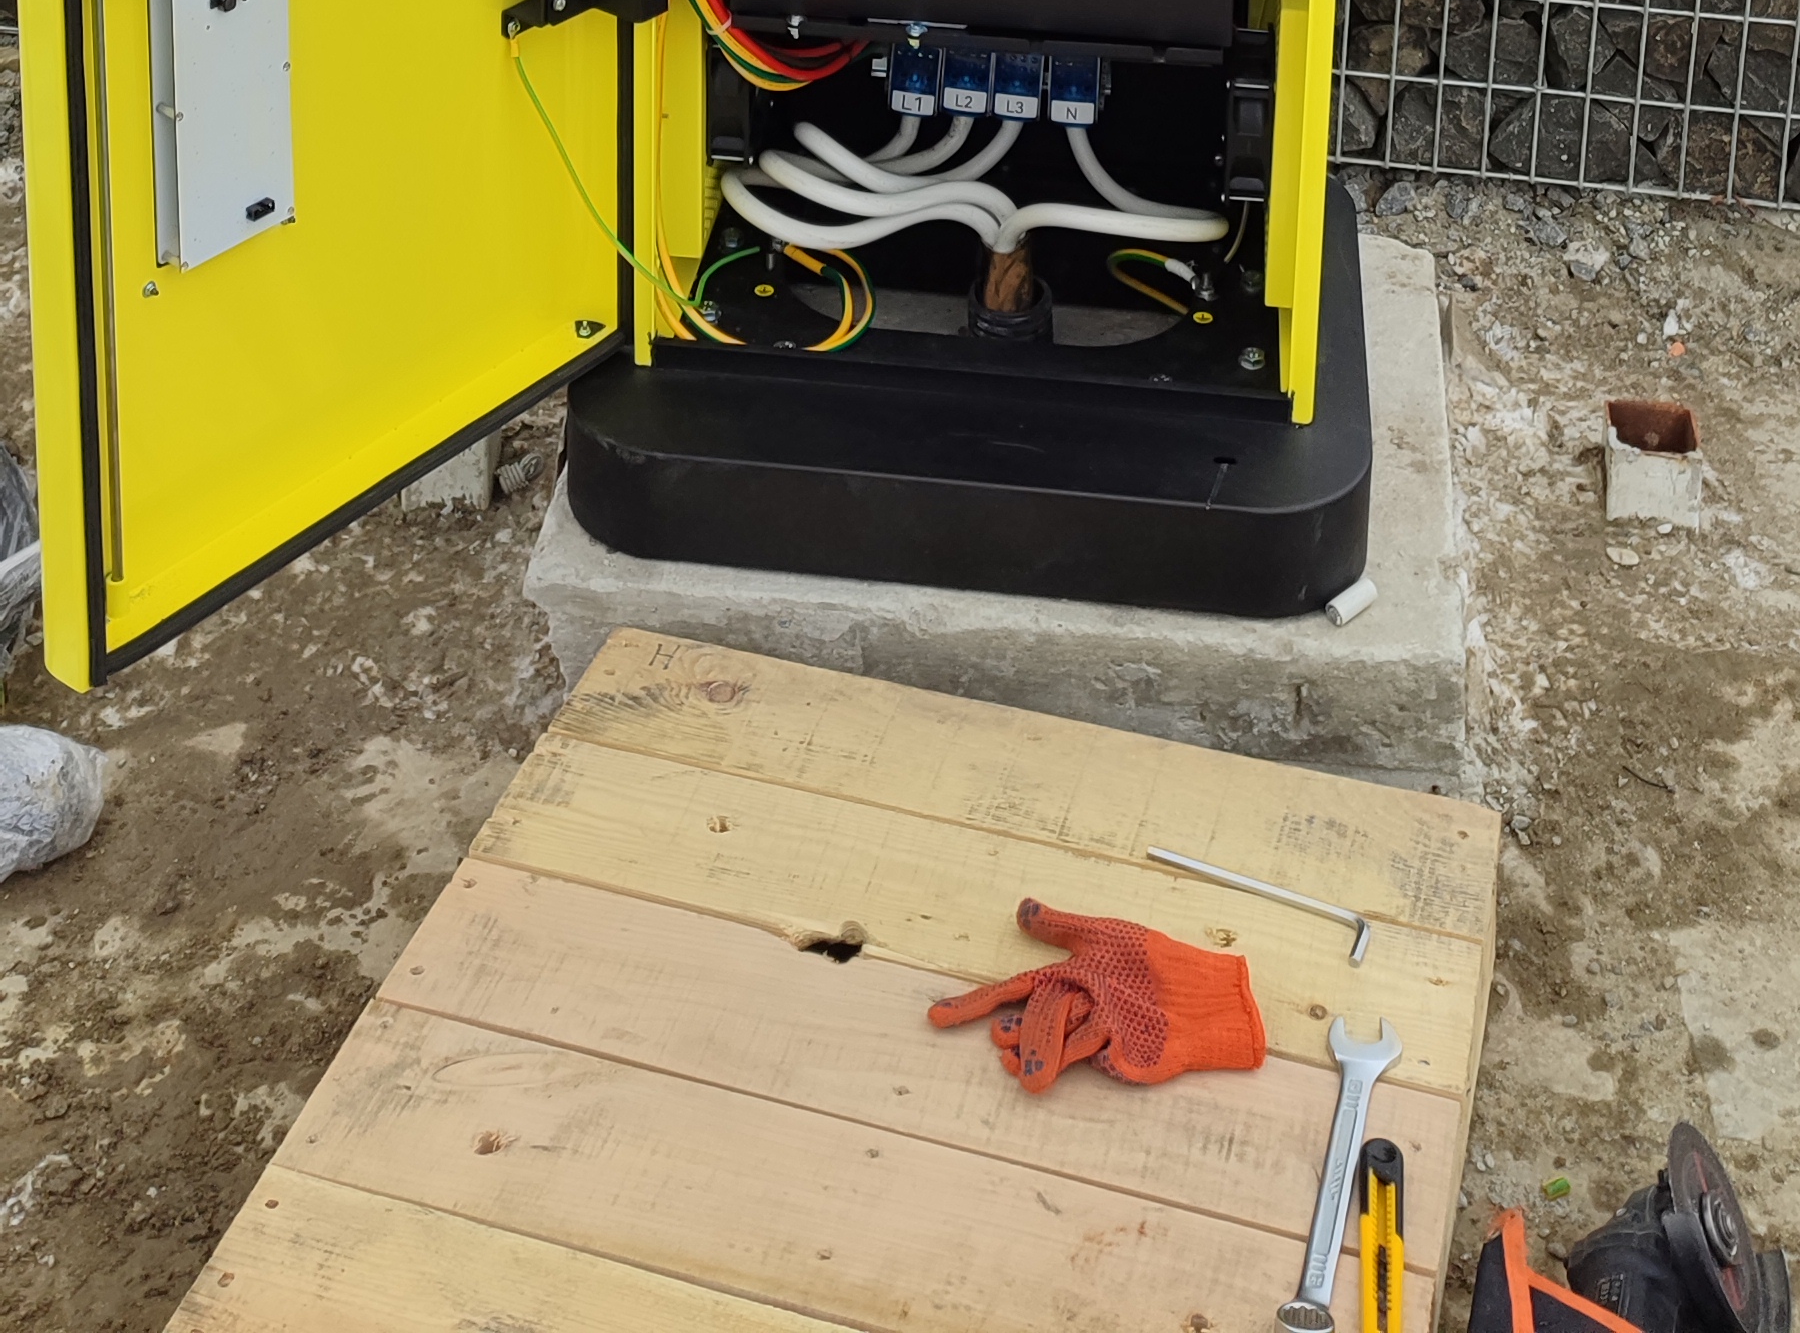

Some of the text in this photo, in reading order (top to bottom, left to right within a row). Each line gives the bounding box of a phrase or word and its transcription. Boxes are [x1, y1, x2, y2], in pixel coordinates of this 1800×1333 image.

[901, 94, 922, 112] L1
[955, 94, 973, 109] L2
[1006, 100, 1024, 114] L3
[1066, 106, 1078, 121] N
